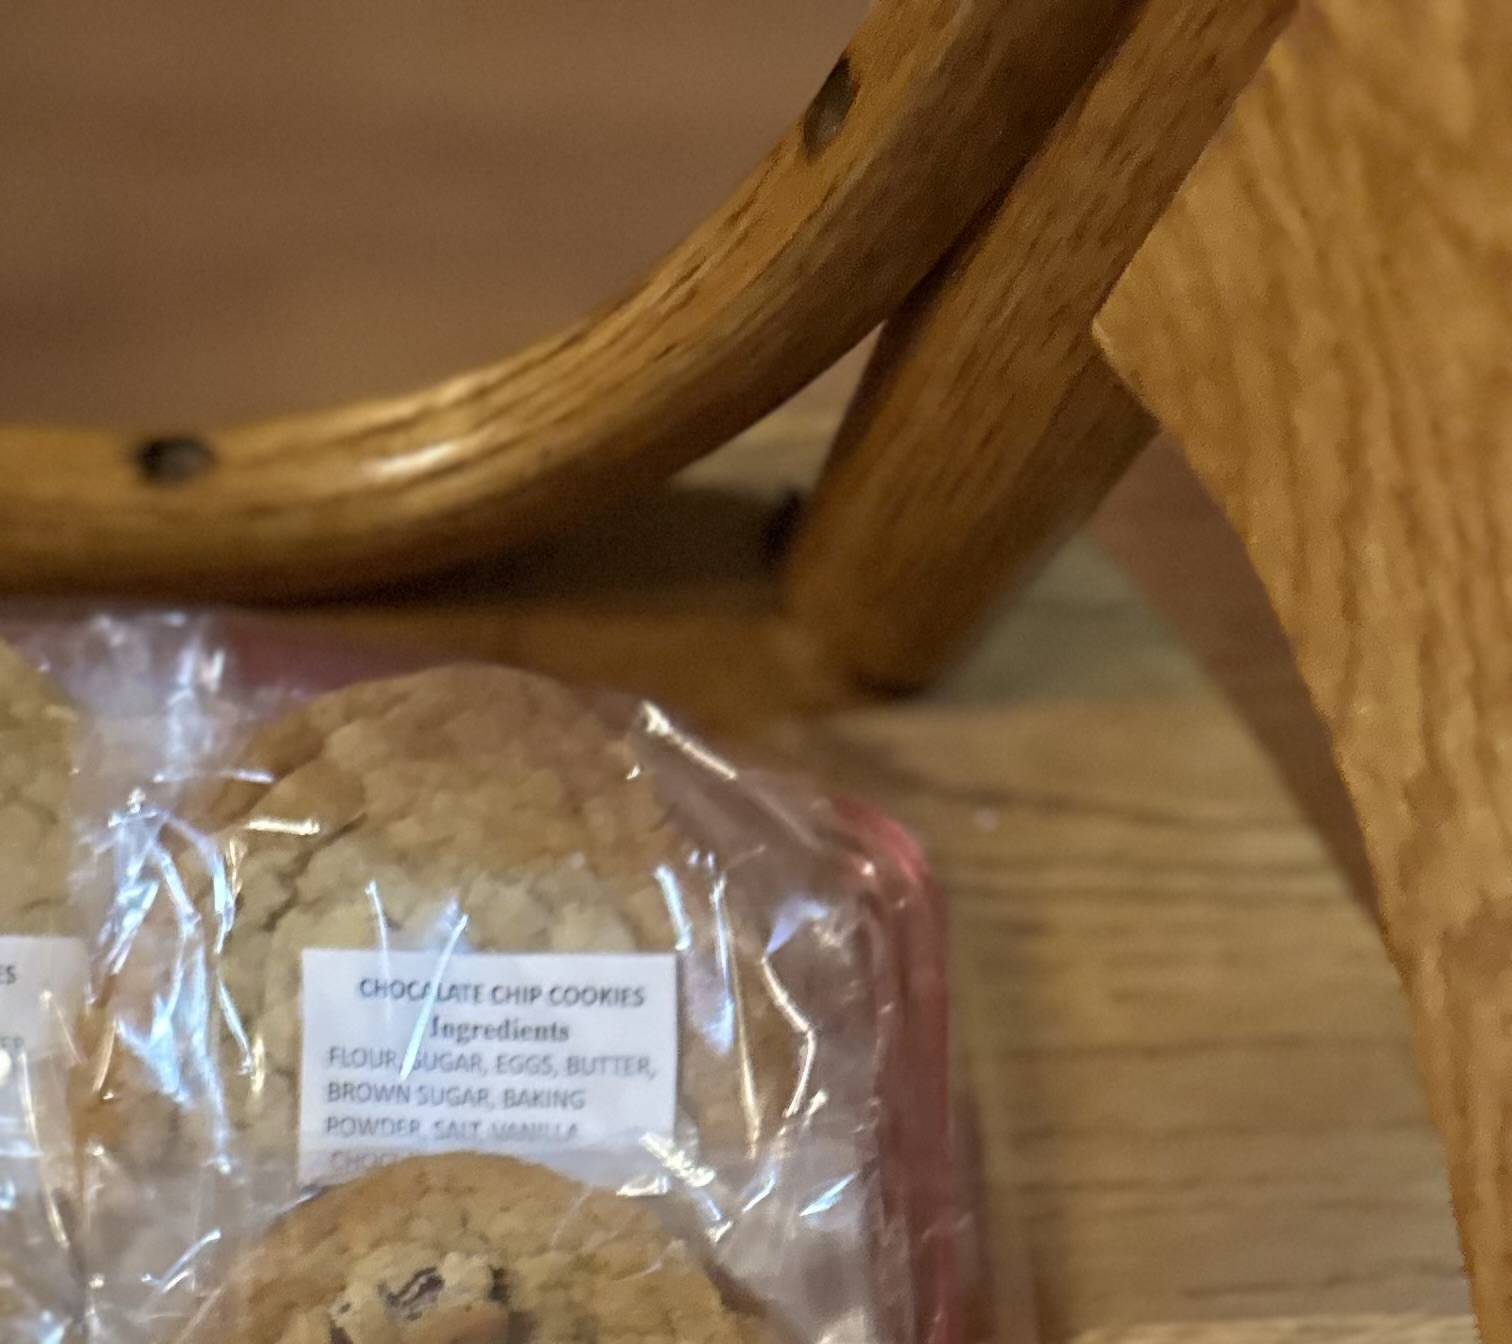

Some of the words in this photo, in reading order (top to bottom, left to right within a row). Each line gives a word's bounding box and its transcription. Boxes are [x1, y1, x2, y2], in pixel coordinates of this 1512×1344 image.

[359, 978, 483, 1004] CHOCALATE
[491, 985, 542, 1006] CHIP
[549, 987, 645, 1008] COOKIES
[428, 1018, 570, 1045] Ingredients
[496, 1054, 558, 1078] EGGS,
[567, 1056, 657, 1081] BUTTER,
[328, 1081, 411, 1103] BROWN
[502, 1088, 587, 1110] BAKING
